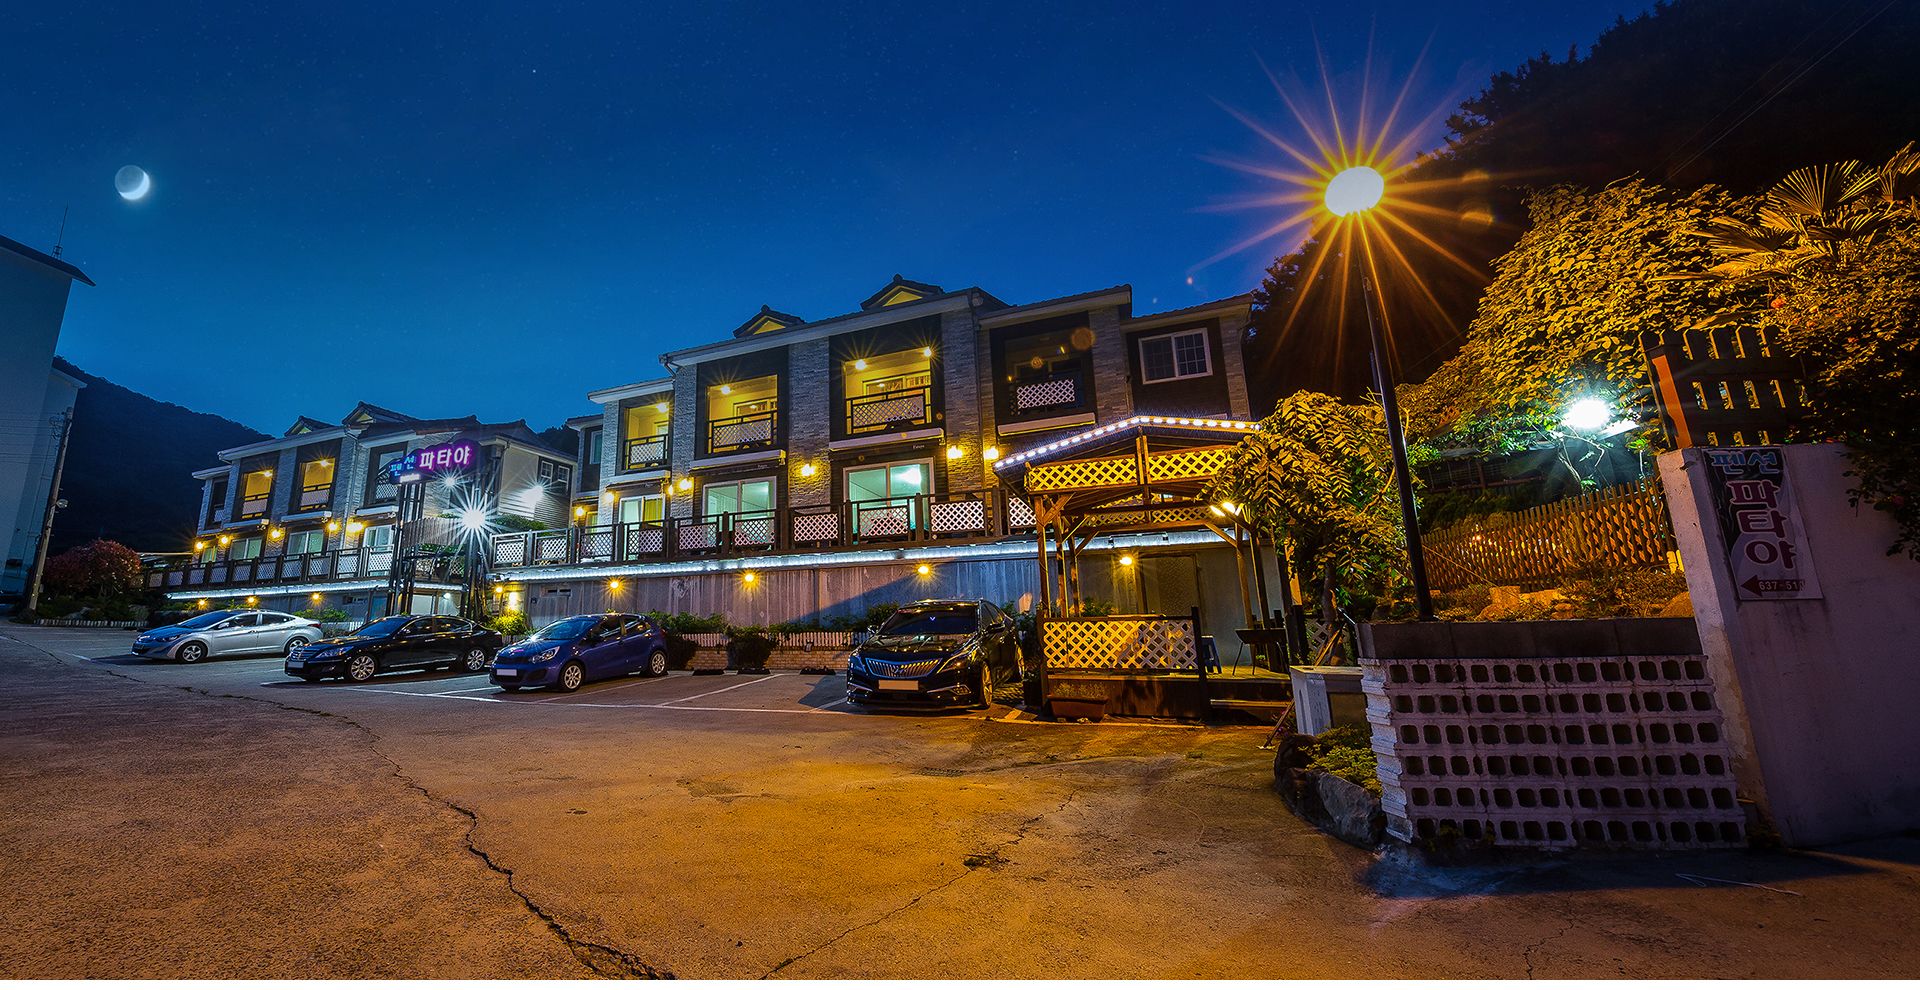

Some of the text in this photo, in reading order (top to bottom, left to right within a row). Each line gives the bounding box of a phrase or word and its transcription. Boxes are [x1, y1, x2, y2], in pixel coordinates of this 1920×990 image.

[389, 446, 470, 476] 펜션 파타야
[1711, 451, 1780, 474] 펜션
[1726, 480, 1797, 570] 파타야
